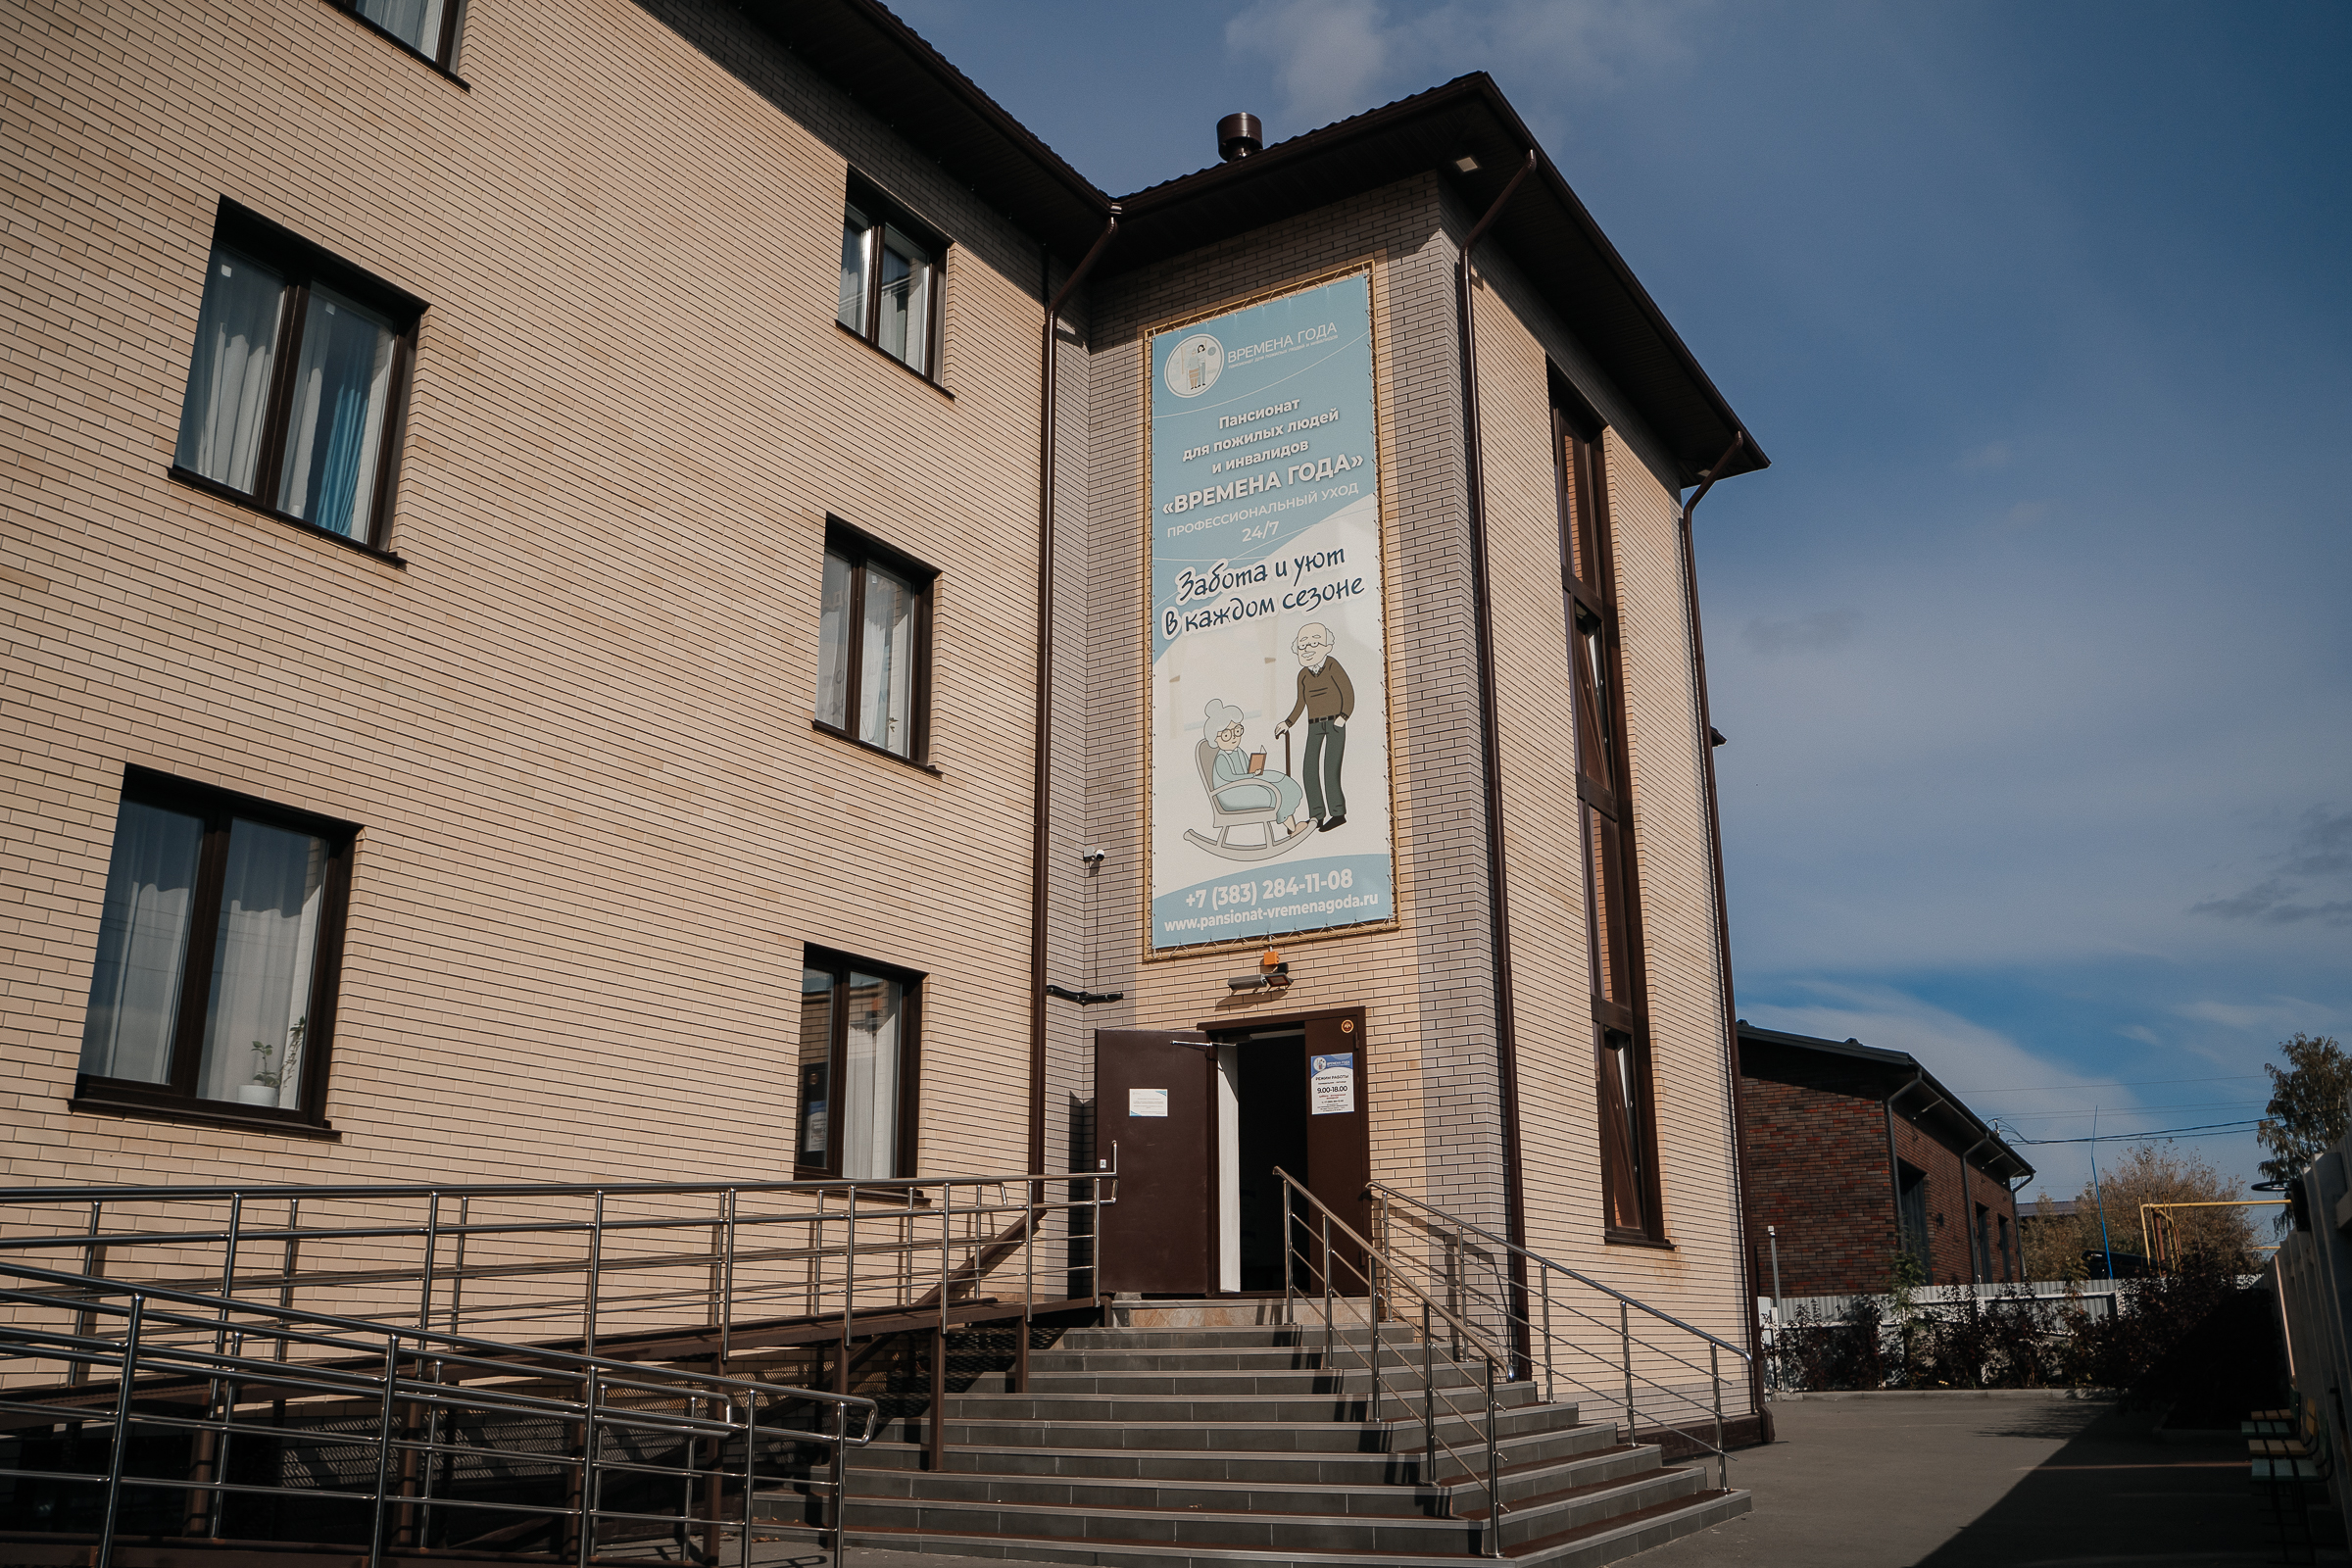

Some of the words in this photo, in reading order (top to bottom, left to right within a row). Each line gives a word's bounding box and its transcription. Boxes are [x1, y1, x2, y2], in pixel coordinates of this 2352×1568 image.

[1228, 334, 1294, 364] ВРЕМЕНА
[1298, 322, 1338, 344] ГОДА
[1182, 444, 1210, 463] для
[1213, 424, 1284, 453] пожилых
[1287, 407, 1340, 433] людей
[1219, 399, 1300, 430] Пансионат
[1211, 463, 1222, 474] и
[1226, 440, 1309, 471] инвалидов
[1162, 471, 1282, 515] «ВРЕМЕНА
[1288, 453, 1364, 486] ГОДА»
[1167, 491, 1318, 538] ПРОФЕССИОНАЛЬНЫЙ
[1321, 482, 1359, 501] УХОД
[1242, 520, 1280, 543] 24/7
[1178, 563, 1269, 602] Забота
[1275, 560, 1288, 577] и
[1294, 548, 1346, 587] уют
[1185, 597, 1275, 632] каждом
[1282, 577, 1365, 612] сезоне
[1185, 889, 1207, 908] +7
[1211, 880, 1257, 911] (383)
[1262, 868, 1353, 901] 284-11-08
[1164, 894, 1379, 931] www.pansionat-vremenagoda.ru
[1317, 1085, 1348, 1094] 9.00-18.00
